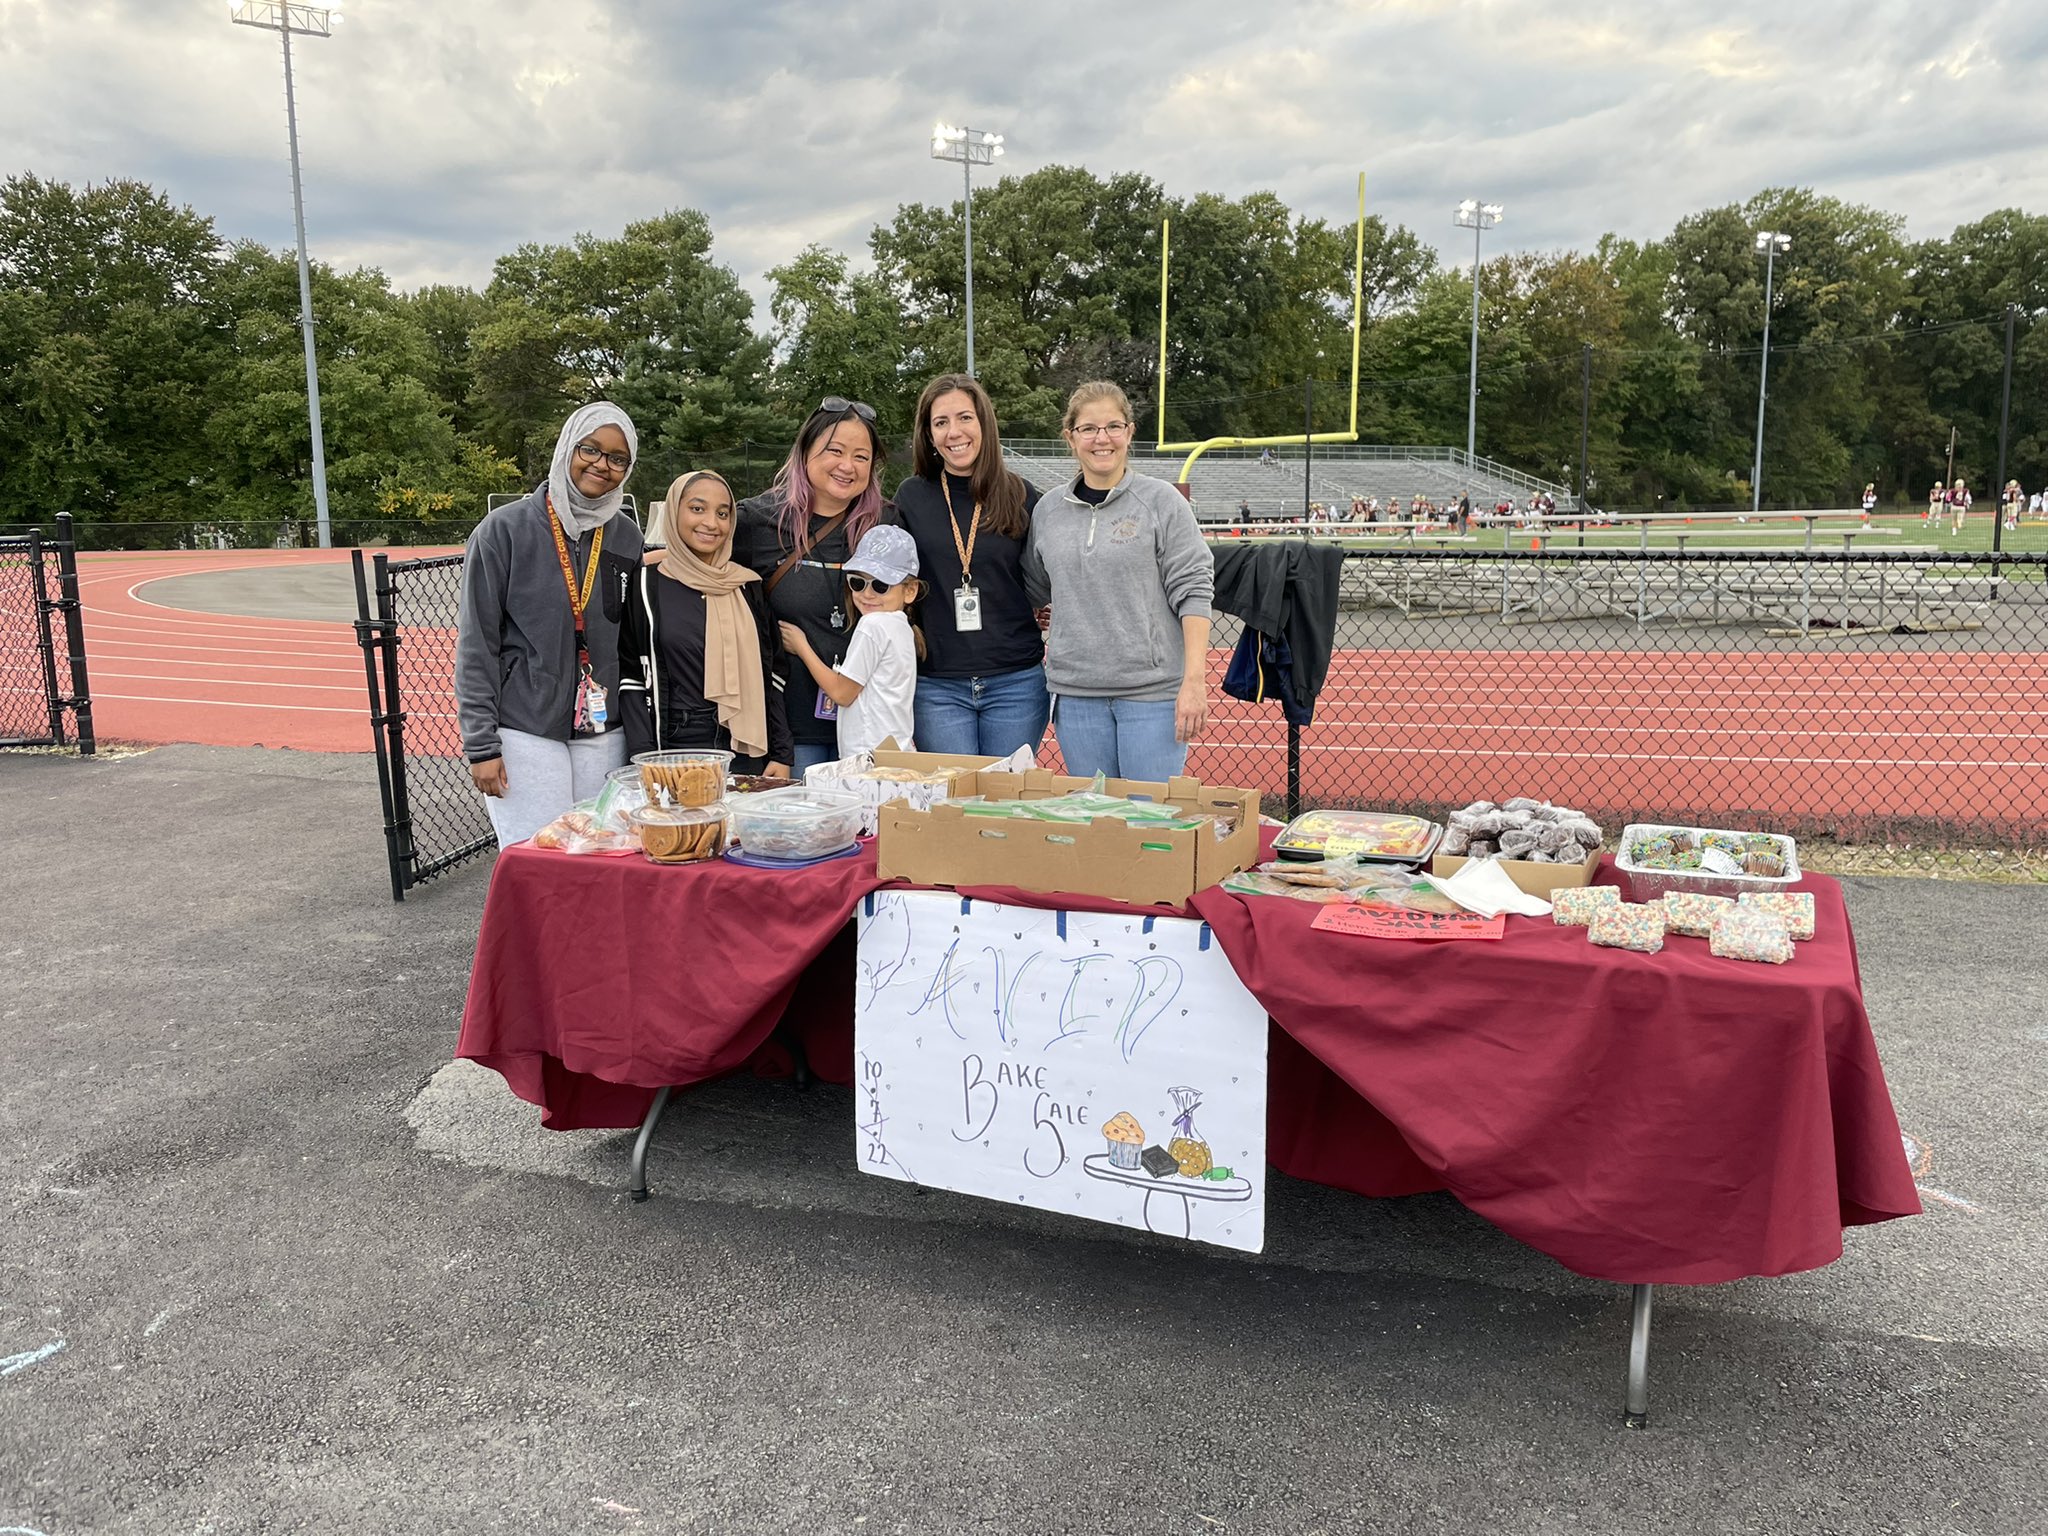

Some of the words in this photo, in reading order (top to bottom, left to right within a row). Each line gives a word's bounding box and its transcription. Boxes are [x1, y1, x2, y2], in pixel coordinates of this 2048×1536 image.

[564, 567, 579, 603] OAKTON
[1373, 918, 1450, 930] SALE
[907, 938, 1184, 1065] AVID
[951, 1053, 1048, 1142] BAKE
[1023, 1092, 1089, 1178] SALE
